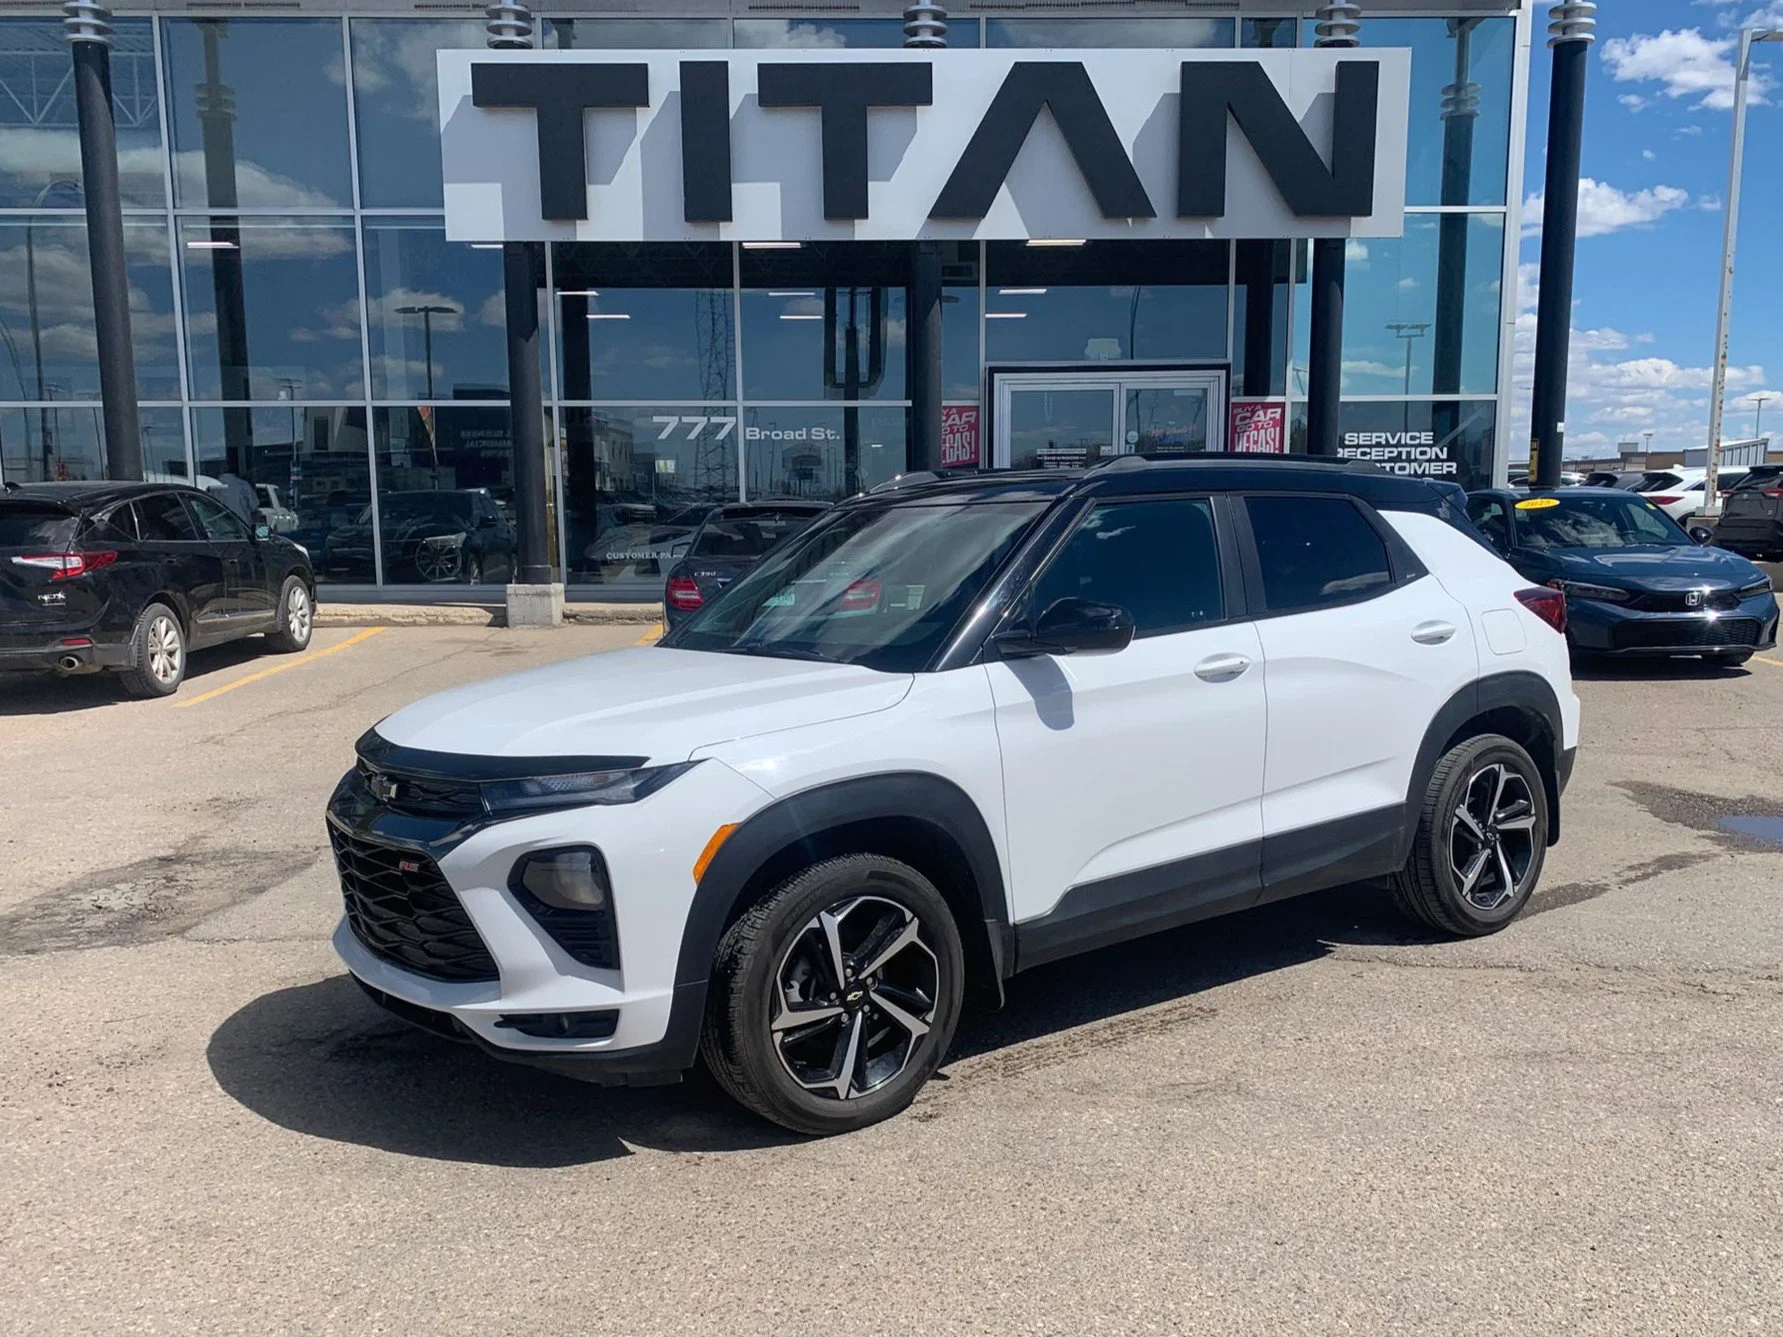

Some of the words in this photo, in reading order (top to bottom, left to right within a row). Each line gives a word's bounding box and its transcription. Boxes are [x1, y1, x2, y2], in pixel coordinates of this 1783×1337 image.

[471, 60, 1379, 223] TITAN
[1233, 405, 1254, 414] BUY
[1235, 408, 1282, 425] CAR
[652, 415, 736, 440] 777
[745, 427, 806, 440] Broad
[811, 427, 841, 440] St.
[952, 424, 968, 433] TO
[1236, 423, 1255, 432] GO
[1256, 420, 1273, 429] TO
[1234, 427, 1280, 454] VEGAS!
[1344, 431, 1434, 445] SERVICE
[942, 430, 976, 464] EGAS!
[1375, 461, 1458, 475] TOMER
[606, 551, 657, 560] CUSTOMER
